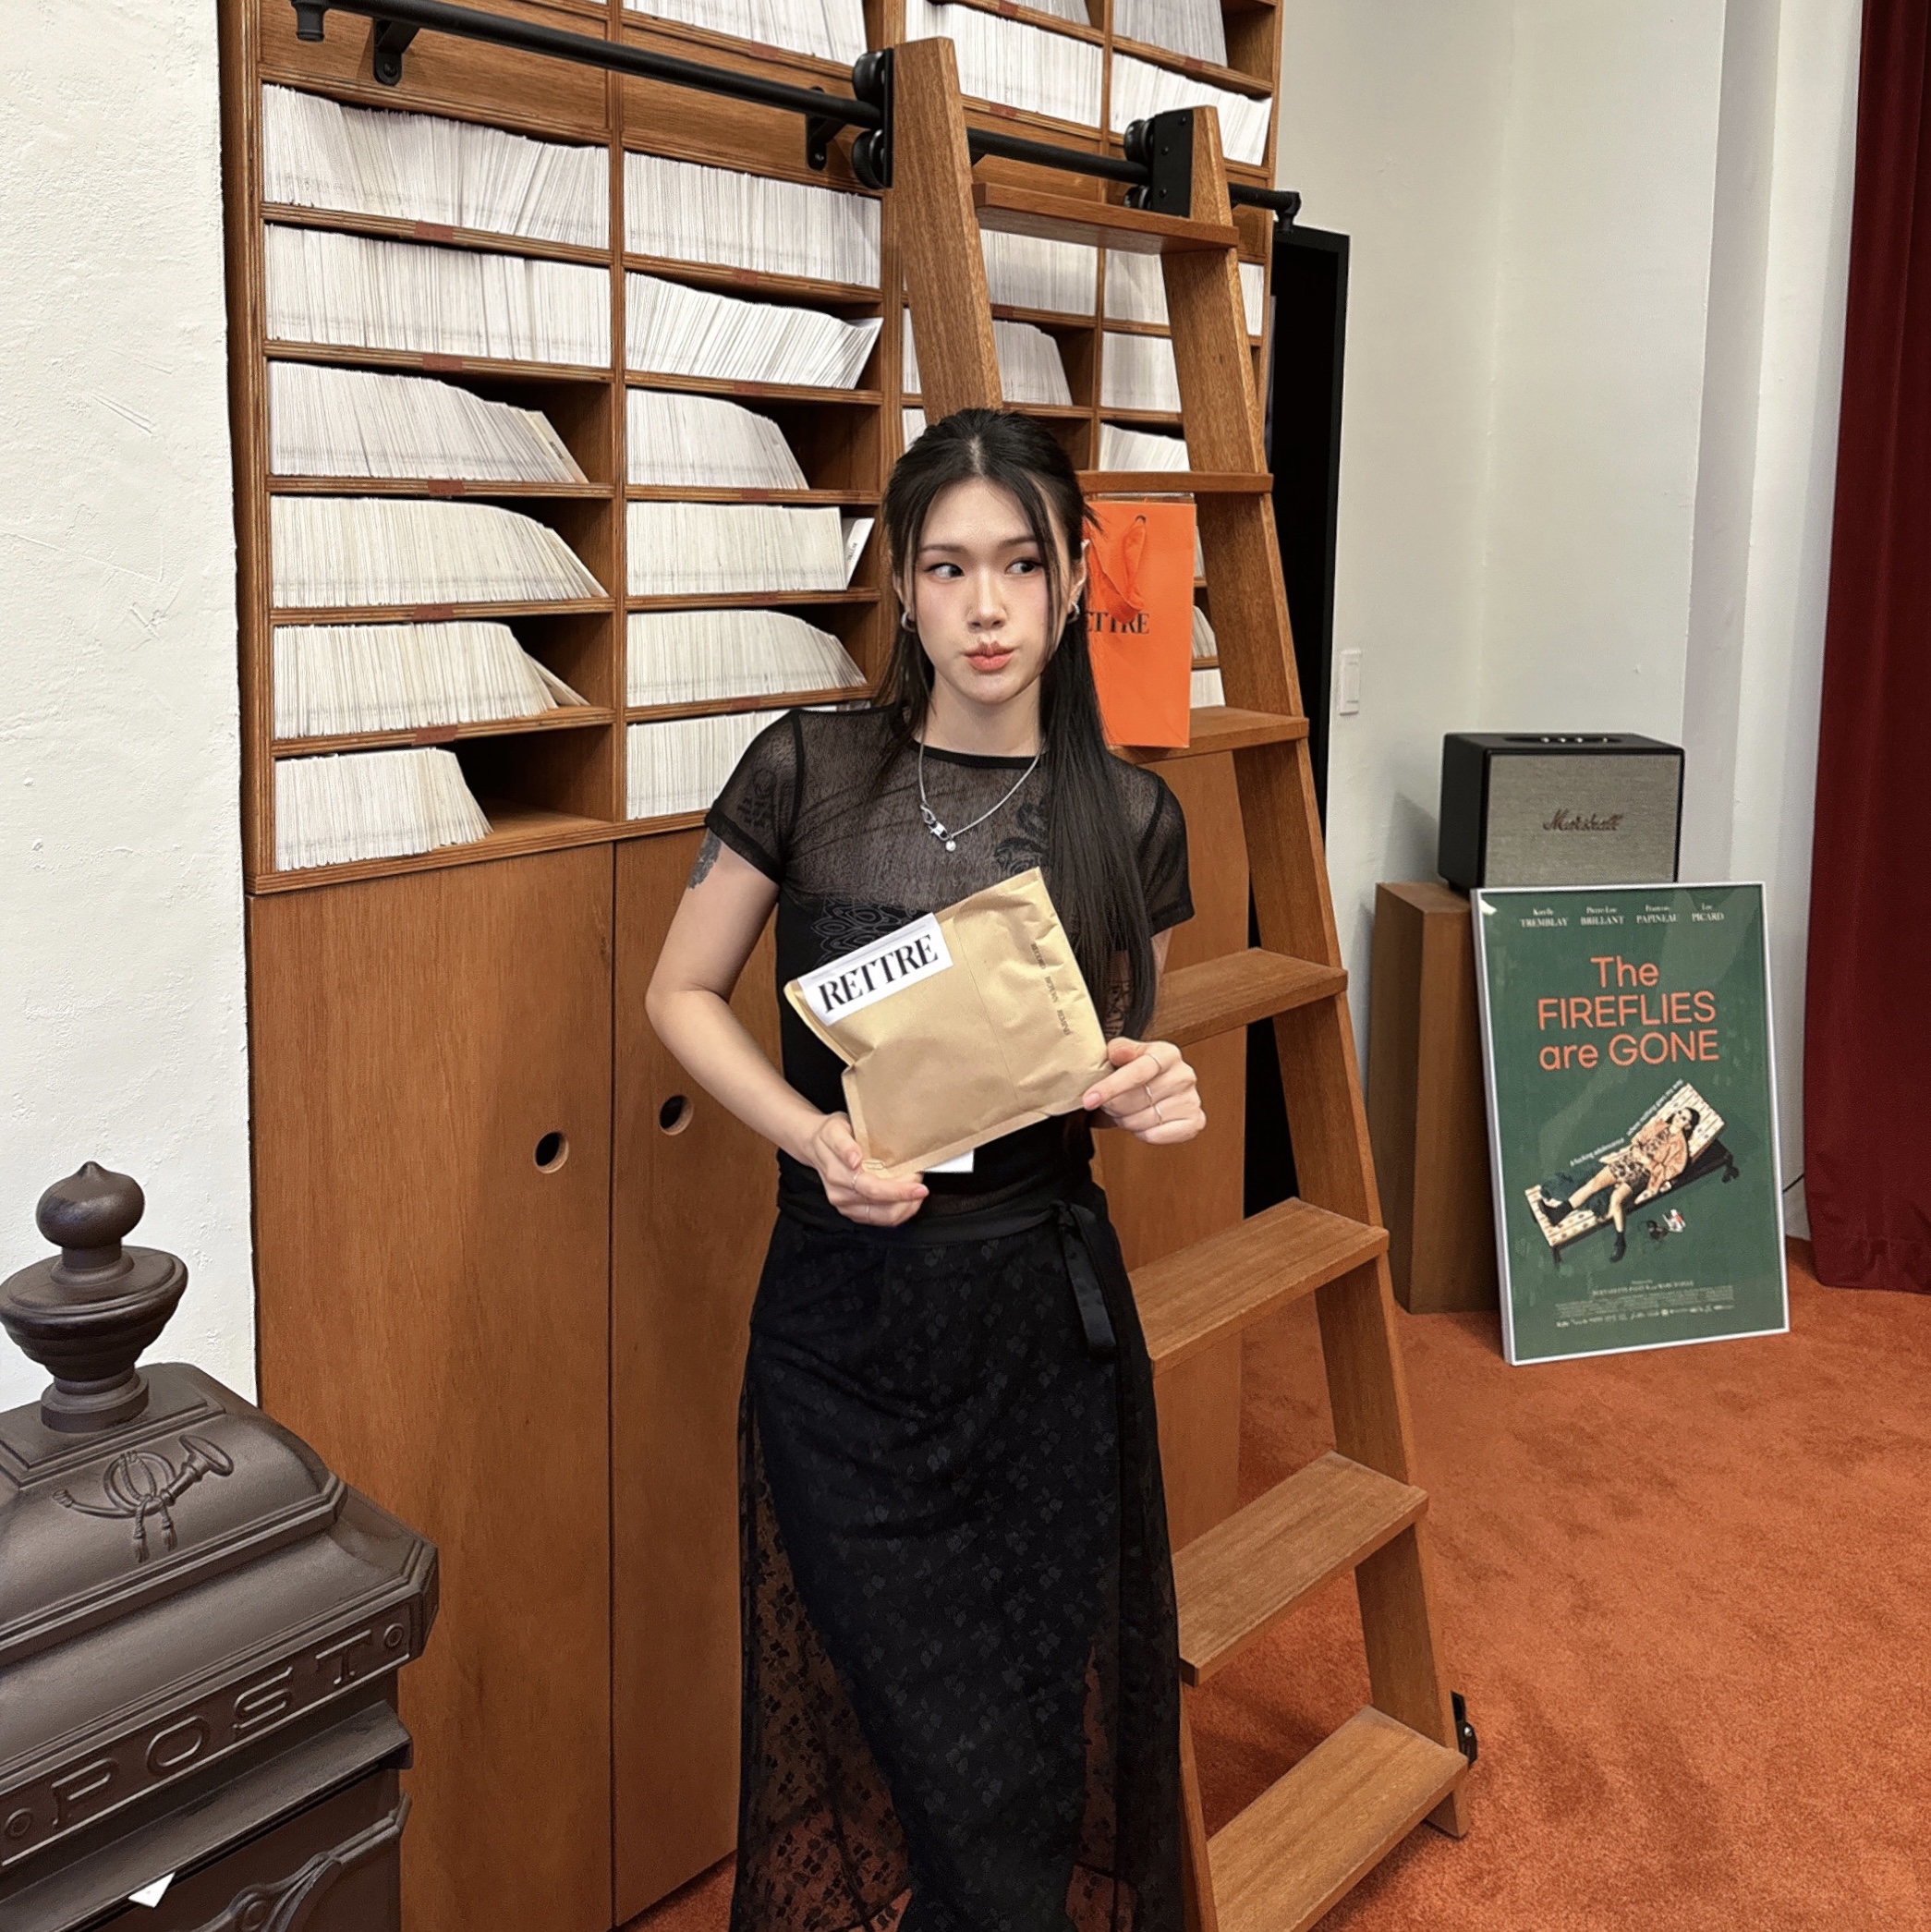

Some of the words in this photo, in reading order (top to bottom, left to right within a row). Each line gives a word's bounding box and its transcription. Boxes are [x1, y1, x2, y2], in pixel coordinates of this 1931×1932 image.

[818, 934, 939, 1014] RETTRE
[1590, 955, 1659, 989] The
[1537, 990, 1717, 1031] FIREFLIES
[1538, 1043, 1599, 1072] are
[1608, 1028, 1720, 1067] GONE
[51, 1628, 372, 1828] POST
